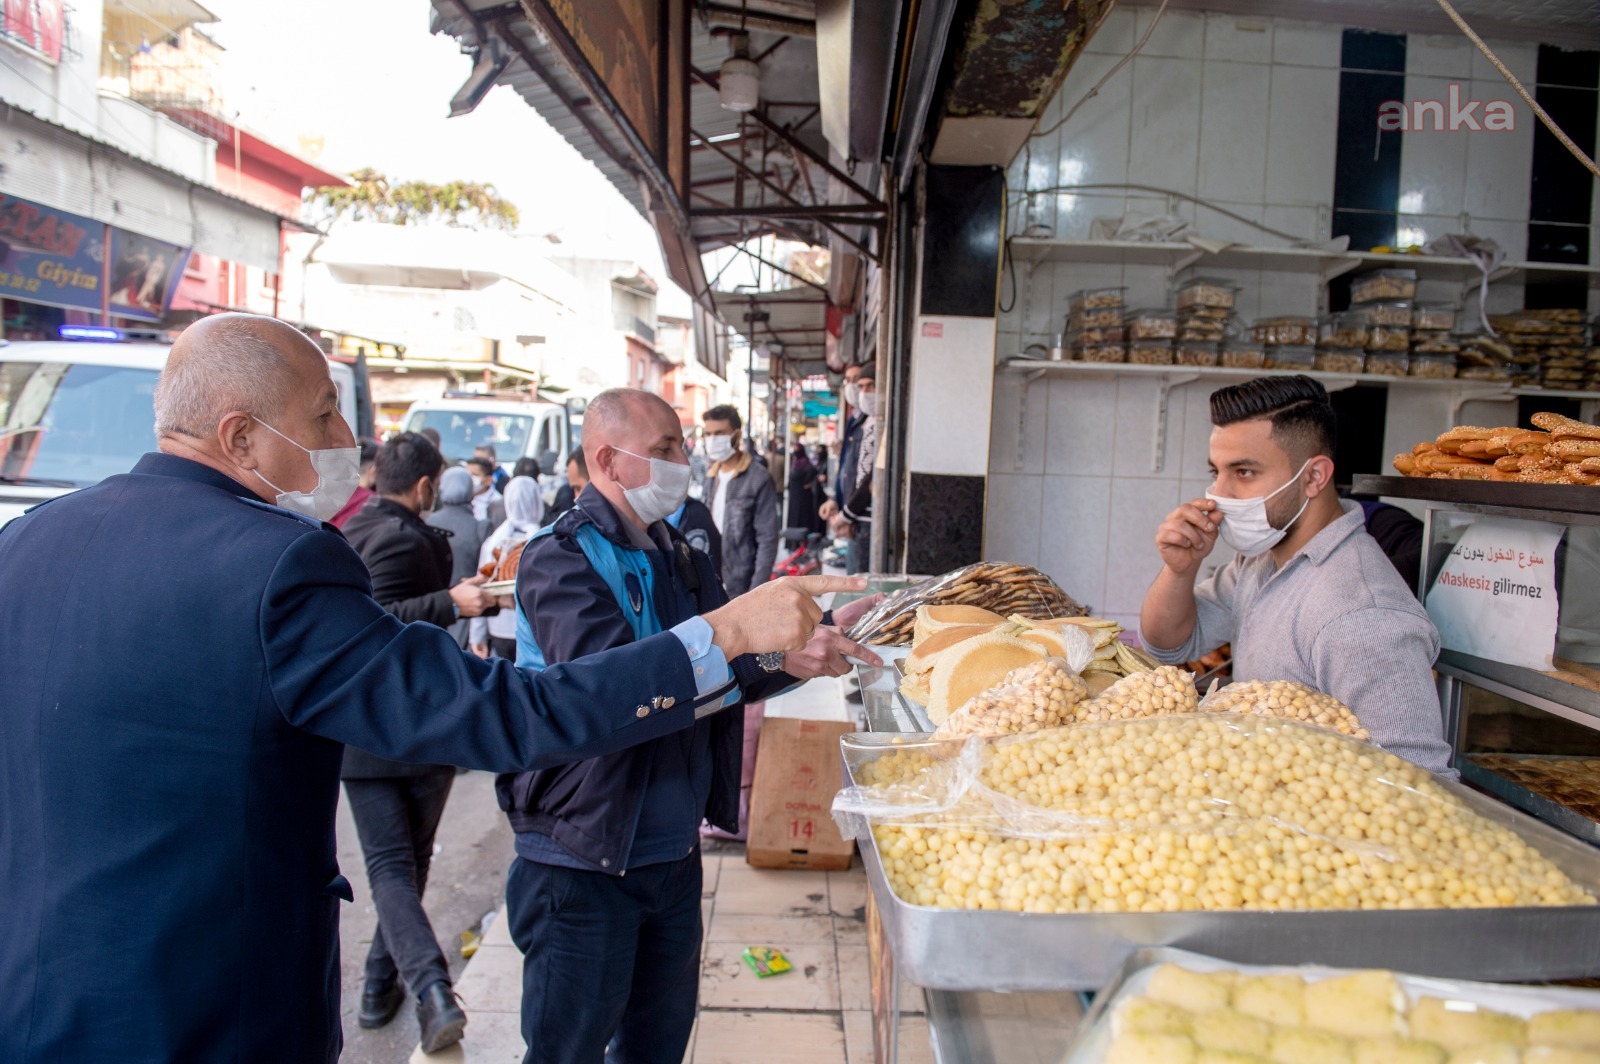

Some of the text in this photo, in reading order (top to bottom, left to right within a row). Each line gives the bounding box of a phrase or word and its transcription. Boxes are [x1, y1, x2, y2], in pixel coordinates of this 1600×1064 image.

[37, 260, 98, 290] Giyim
[1463, 547, 1485, 561] بدون
[1487, 547, 1515, 563] الدخول
[1518, 551, 1544, 569] ممنوع
[1493, 578, 1542, 599] gilirmez
[791, 820, 814, 838] 14
